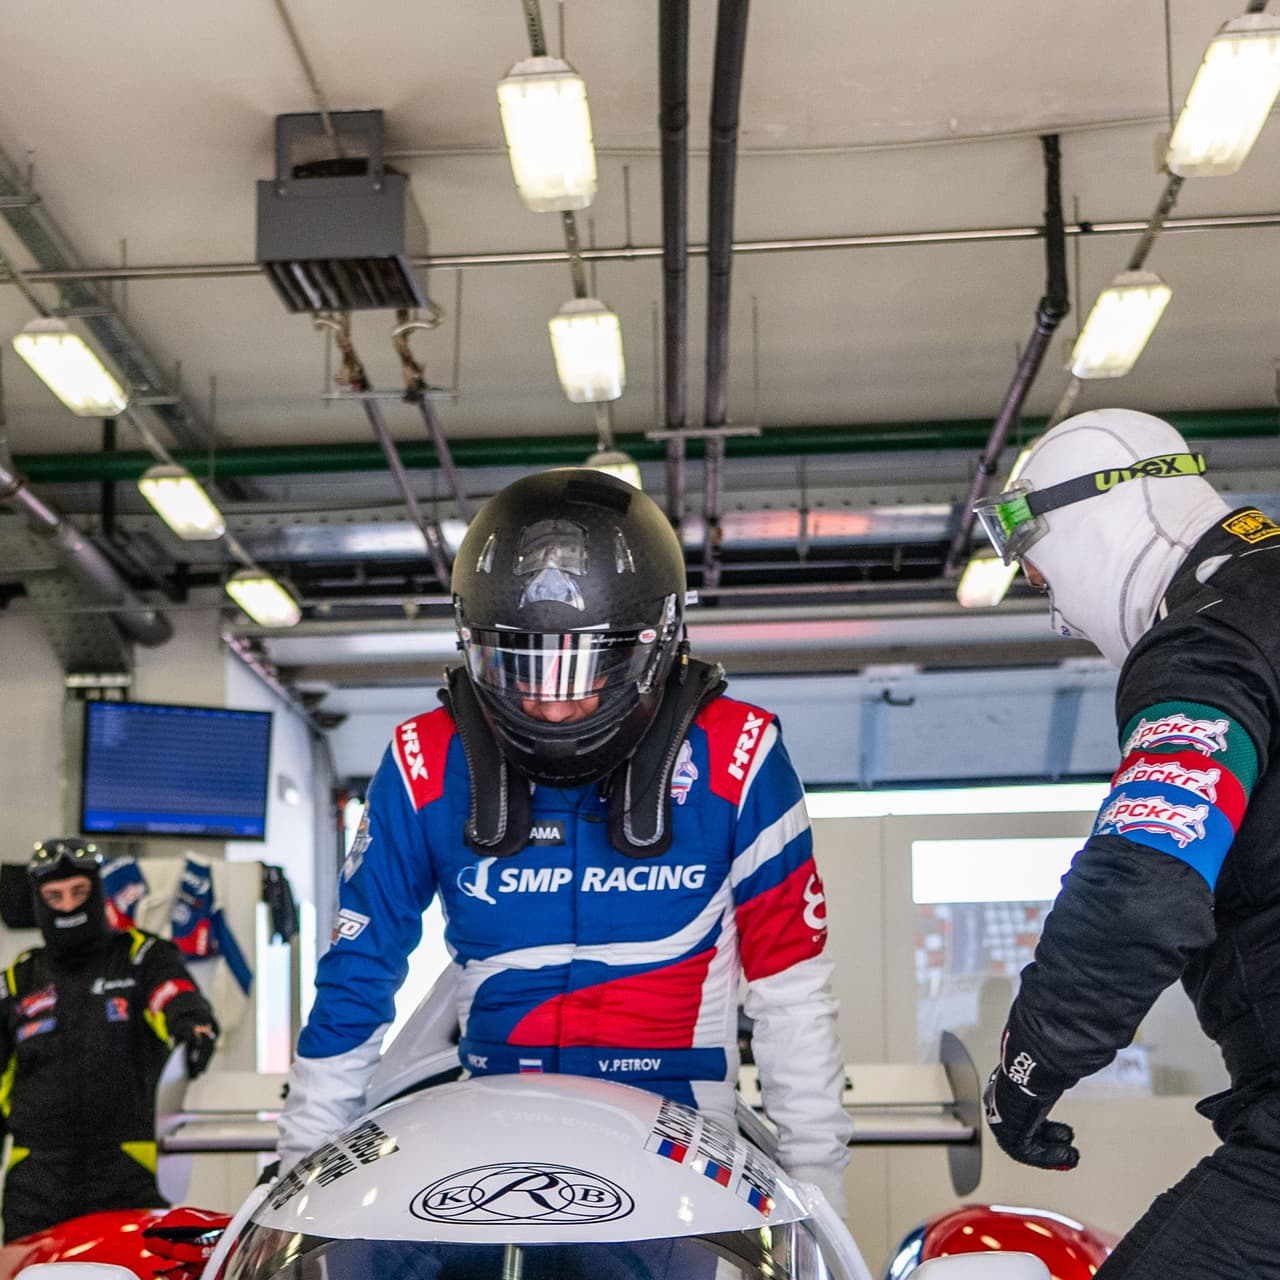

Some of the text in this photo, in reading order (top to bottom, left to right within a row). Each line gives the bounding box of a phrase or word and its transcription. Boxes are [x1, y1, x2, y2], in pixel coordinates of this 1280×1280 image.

[1138, 722, 1208, 742] РСКГ
[401, 722, 428, 780] HRX
[727, 712, 764, 780] HRX
[1113, 803, 1187, 820] РСКГ
[529, 827, 561, 840] AMA
[498, 864, 707, 893] SMP RACING
[598, 1058, 662, 1073] V.PETROV
